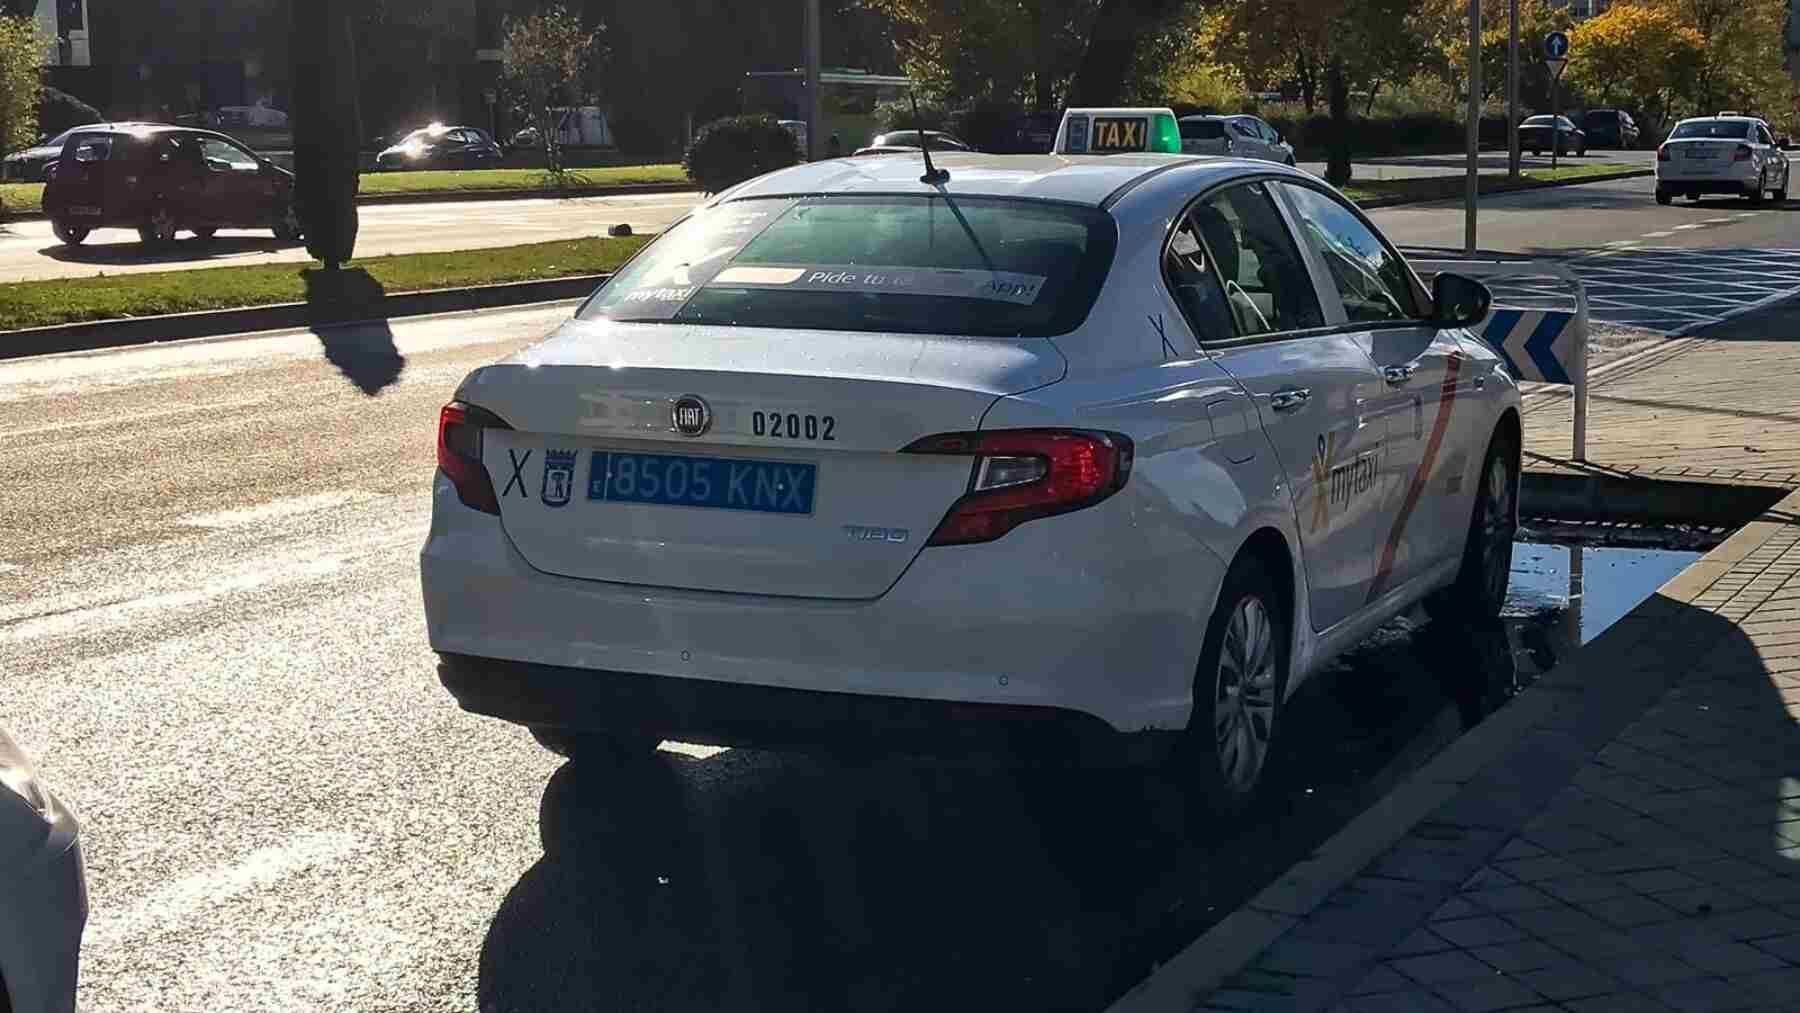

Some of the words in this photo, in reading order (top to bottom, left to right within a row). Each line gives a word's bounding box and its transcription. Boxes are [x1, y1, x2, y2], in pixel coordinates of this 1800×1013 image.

[1095, 121, 1146, 147] TAXI
[807, 271, 857, 285] Pide
[1147, 313, 1179, 361] X
[679, 407, 701, 426] FIAT
[752, 411, 836, 441] 02002
[502, 449, 533, 498] X
[614, 456, 712, 501] 8505
[727, 463, 808, 511] KNX
[1329, 452, 1380, 512] mytaxi
